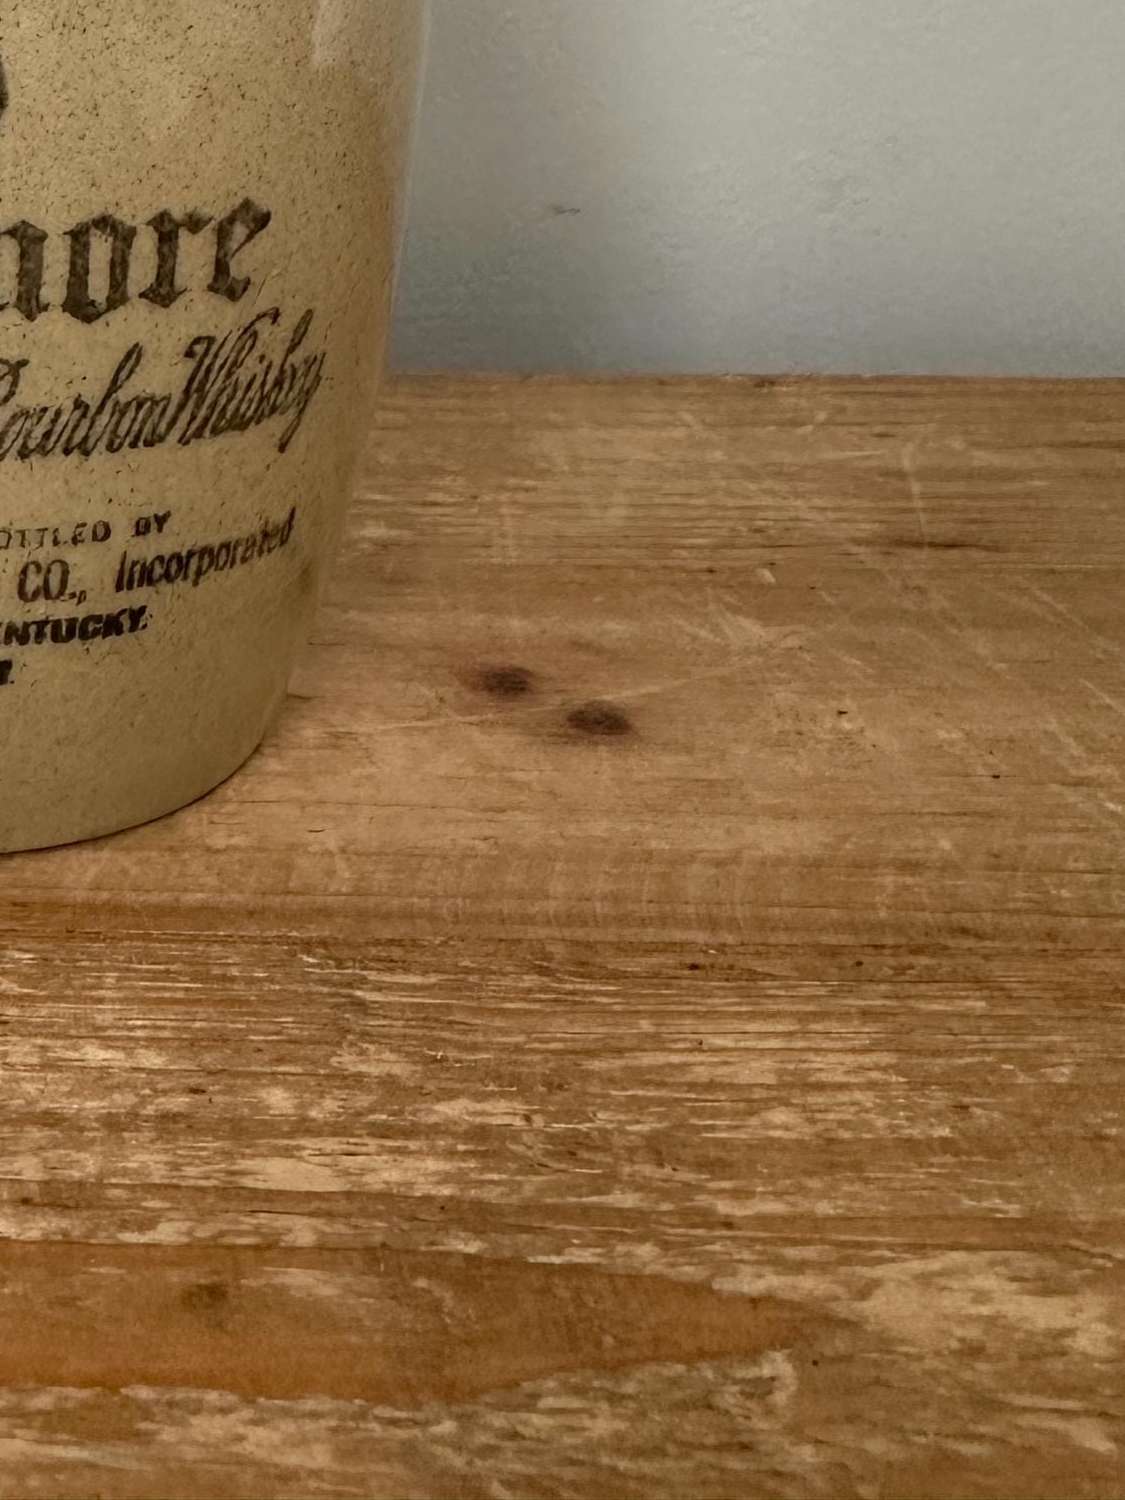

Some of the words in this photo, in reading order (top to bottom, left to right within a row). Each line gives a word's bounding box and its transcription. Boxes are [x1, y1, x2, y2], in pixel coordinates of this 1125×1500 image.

[177, 307, 326, 453] Whisky
[115, 506, 297, 594] Incorporated
[134, 509, 173, 538] BY
